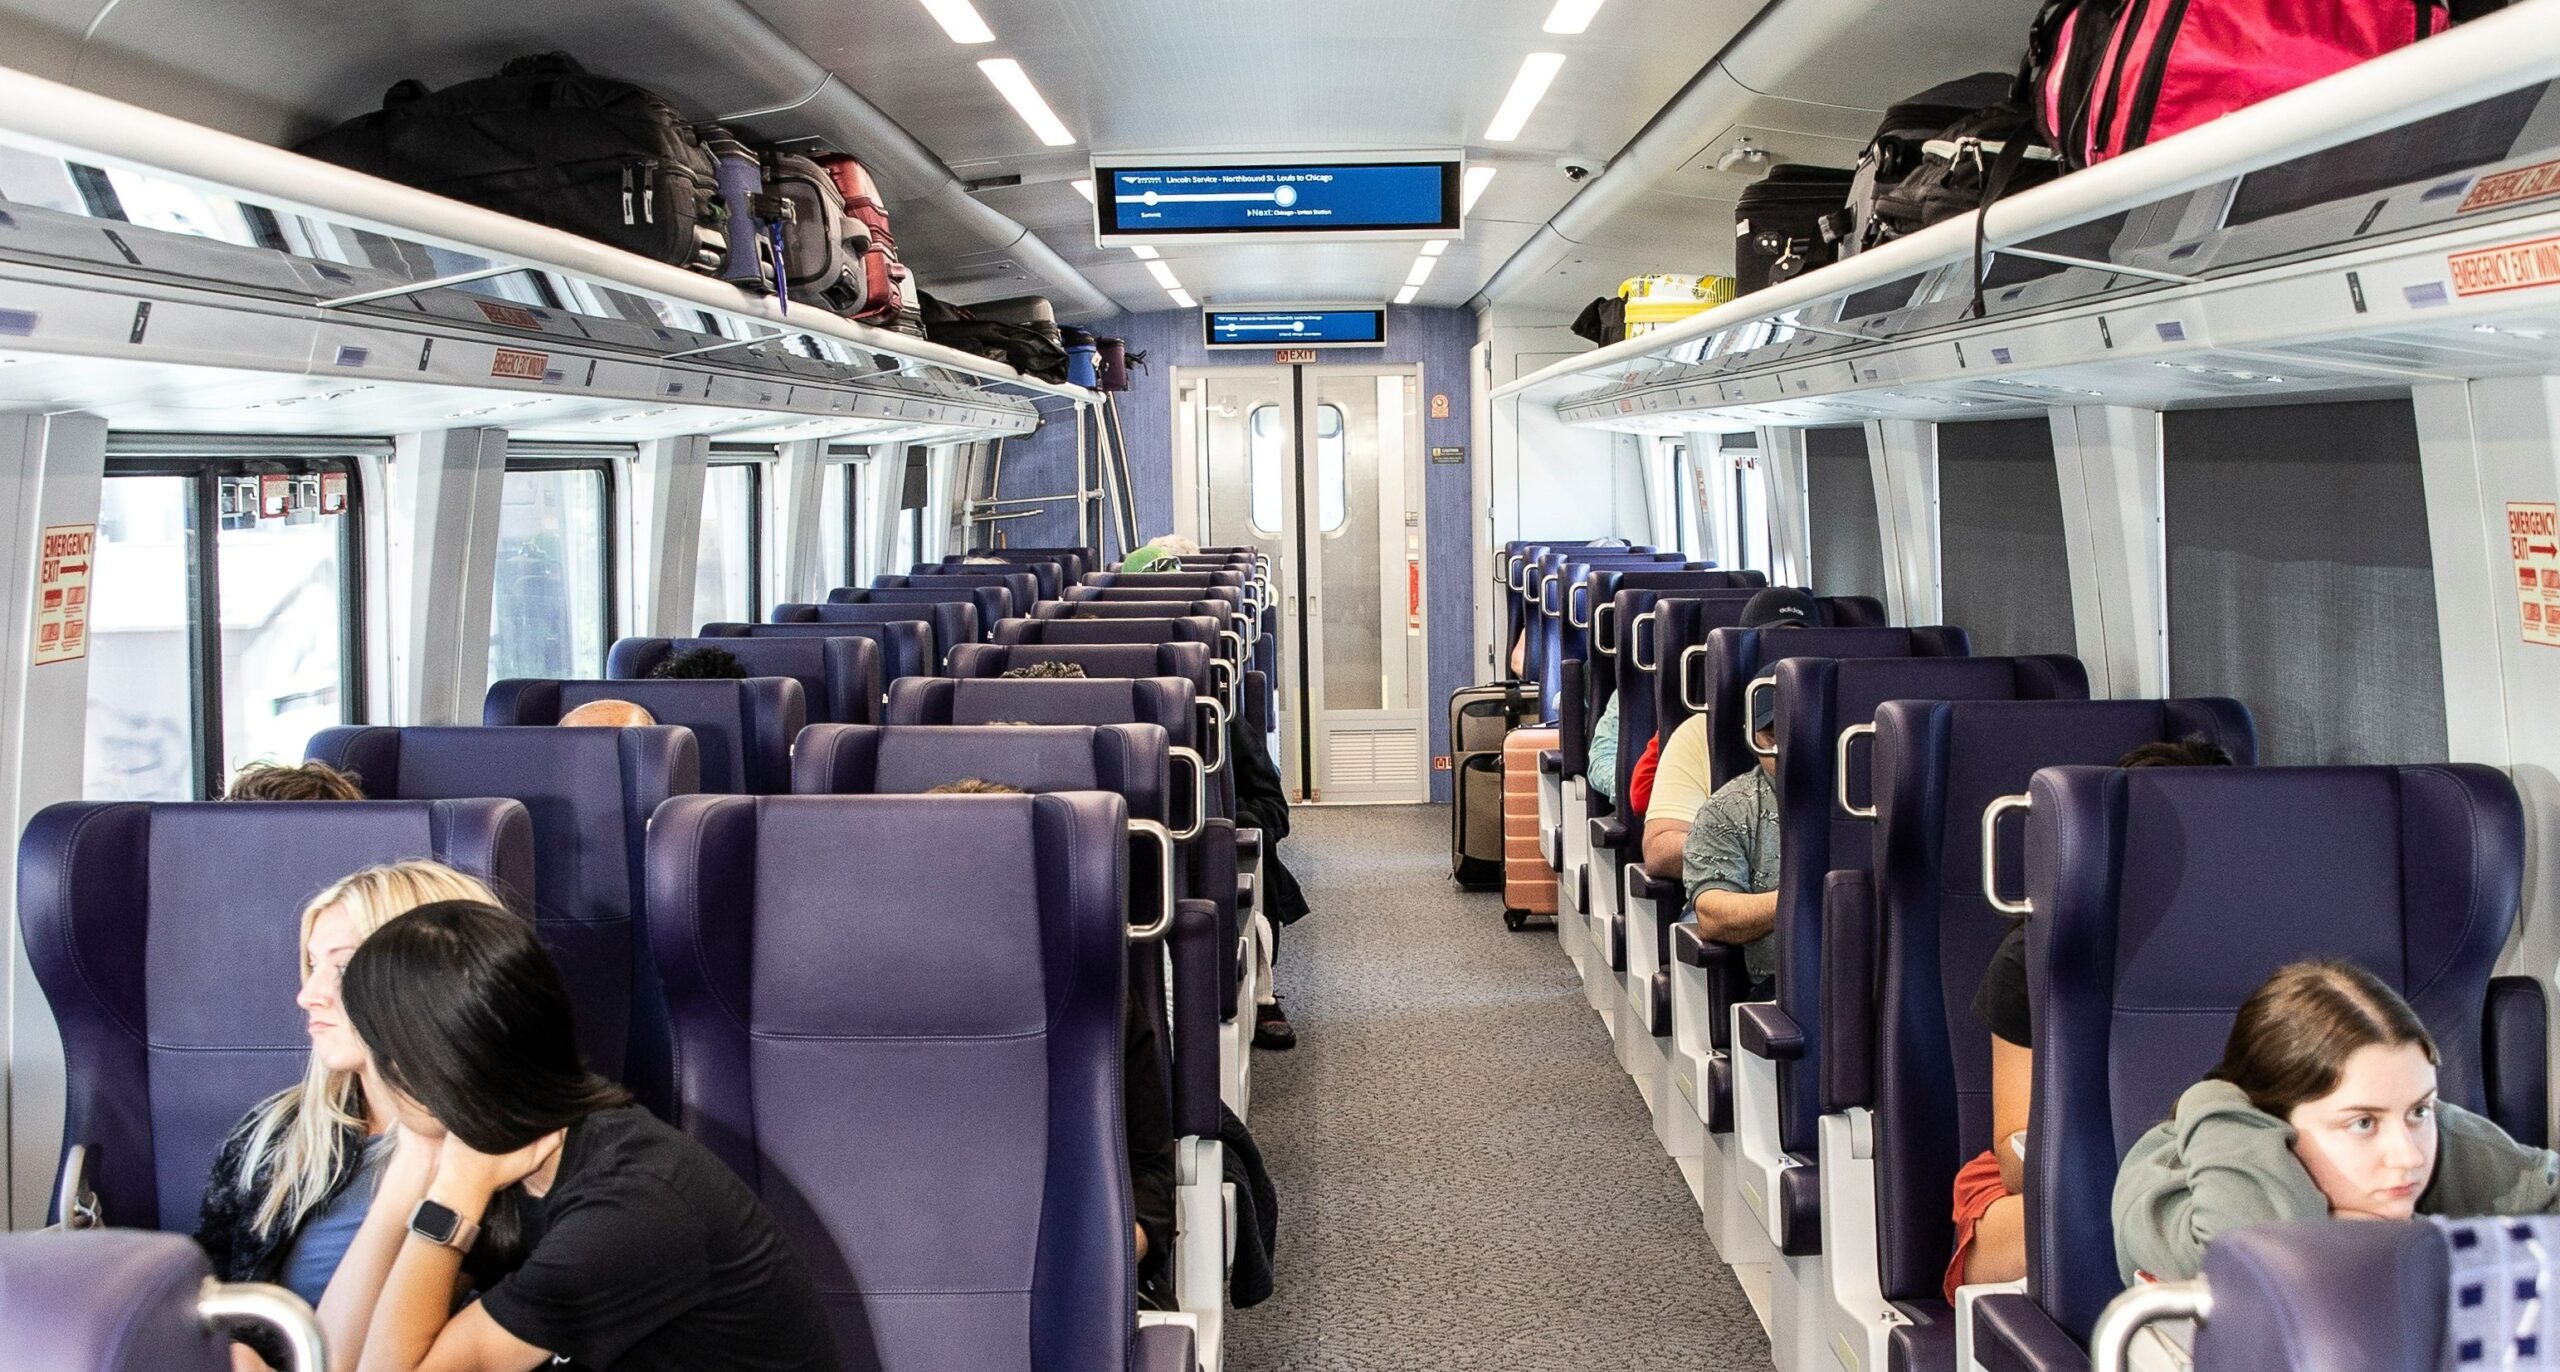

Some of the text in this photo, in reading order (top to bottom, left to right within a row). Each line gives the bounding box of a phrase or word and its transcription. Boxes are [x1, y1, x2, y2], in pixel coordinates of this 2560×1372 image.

[1166, 176, 1191, 184] Lincoln
[1192, 176, 1218, 184] Service
[1222, 174, 1266, 183] Northbound
[1266, 174, 1276, 182] St.
[1277, 173, 1296, 182] Louis
[1305, 173, 1333, 183] Chicago
[1252, 208, 1274, 217] Next:
[2451, 253, 2511, 289] EMERGENCY
[2510, 249, 2534, 281] EXIT
[1290, 350, 1314, 360] EXIT
[2508, 511, 2556, 536] EMERGENCY
[44, 532, 94, 558] EMERGENCY
[2511, 537, 2529, 561] EXIT
[42, 559, 61, 584] EXIT
